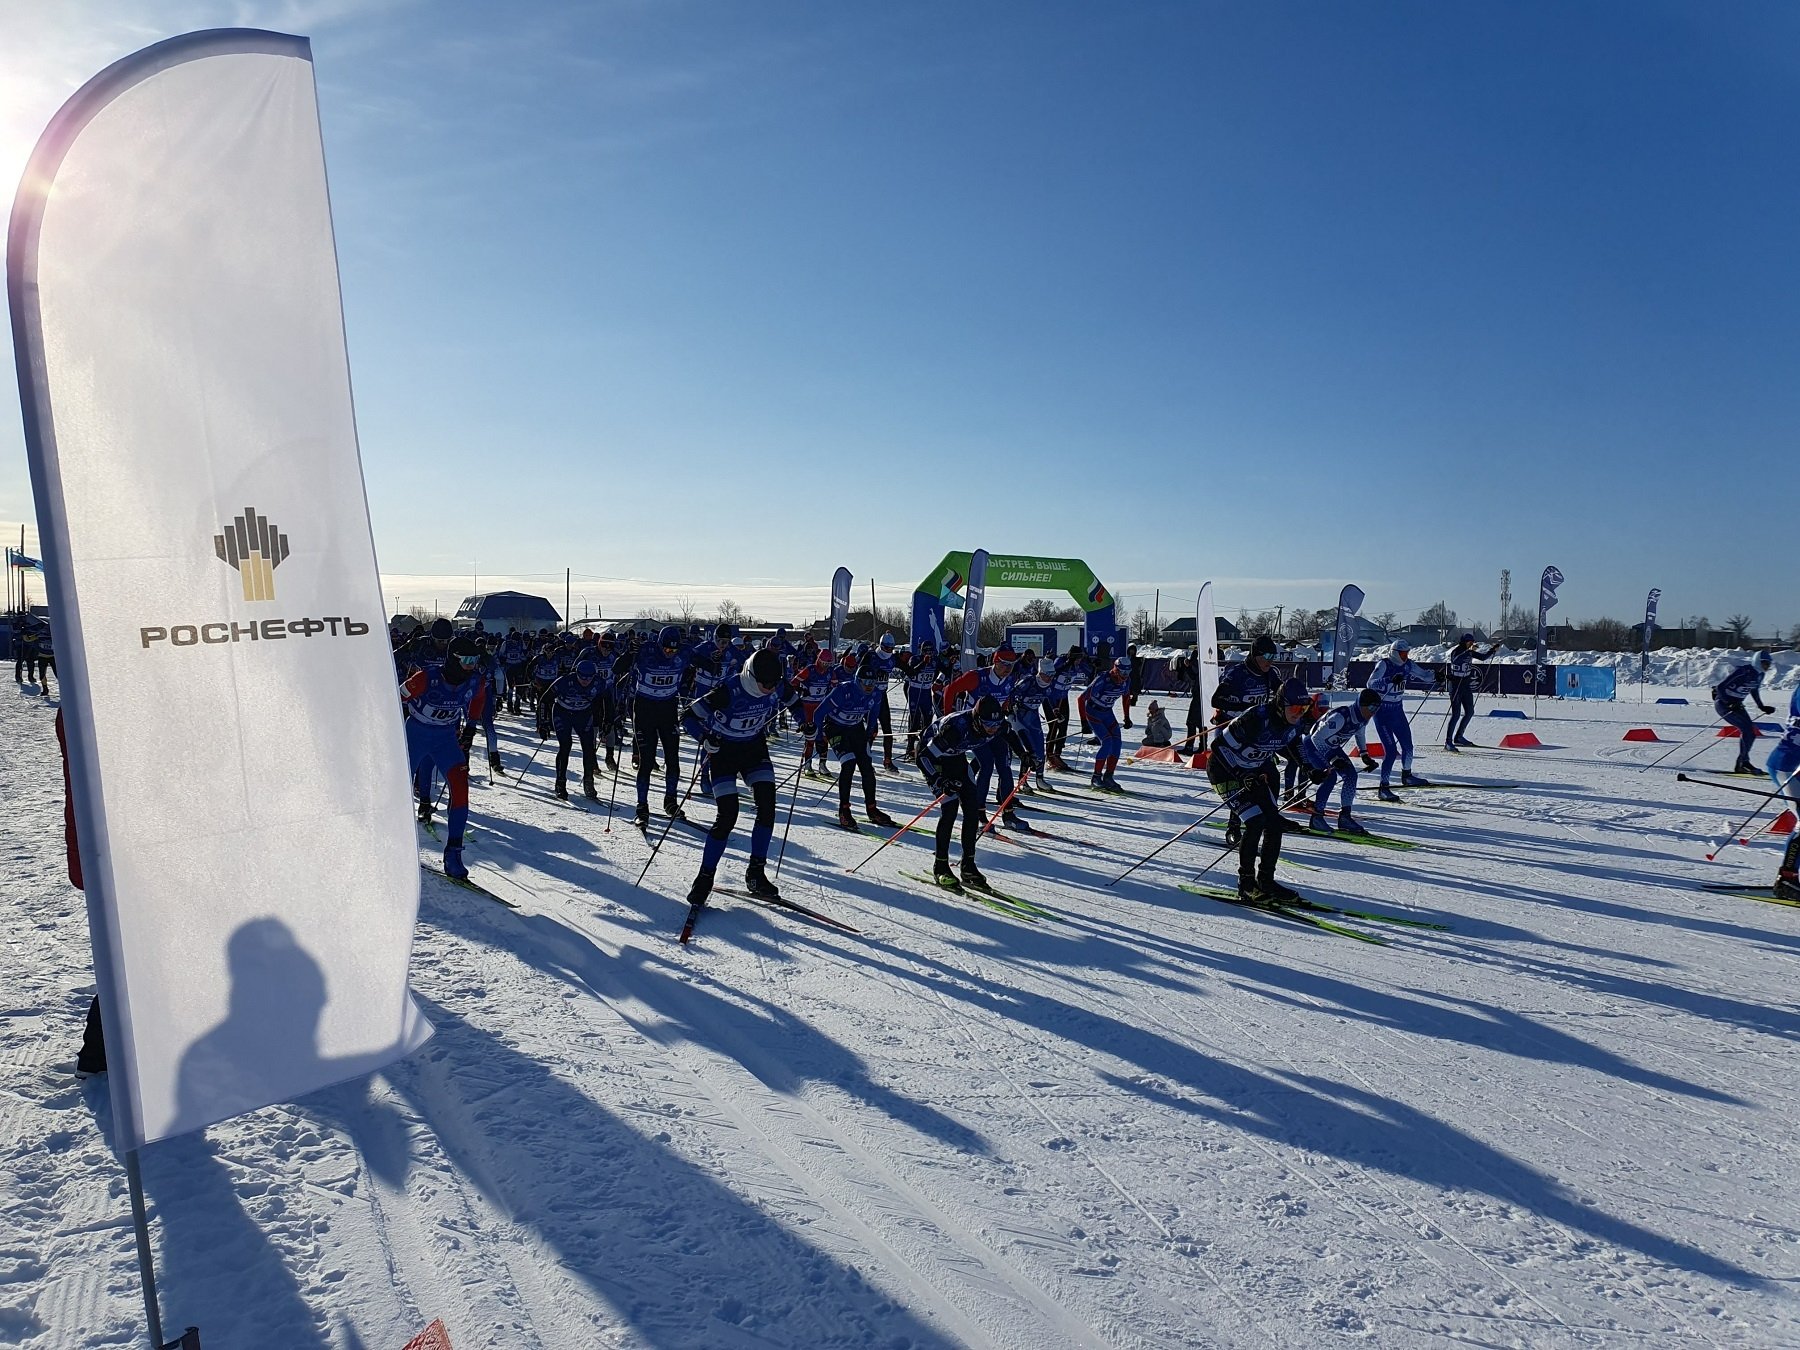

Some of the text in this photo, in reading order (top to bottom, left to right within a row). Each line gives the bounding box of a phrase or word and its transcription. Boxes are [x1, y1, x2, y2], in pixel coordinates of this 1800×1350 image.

[1035, 561, 1071, 571] ВЫШЕ.
[1001, 571, 1053, 583] СИЛЬНЕЕ!
[139, 616, 370, 649] РОСНЕФТЬ
[650, 676, 674, 685] 150
